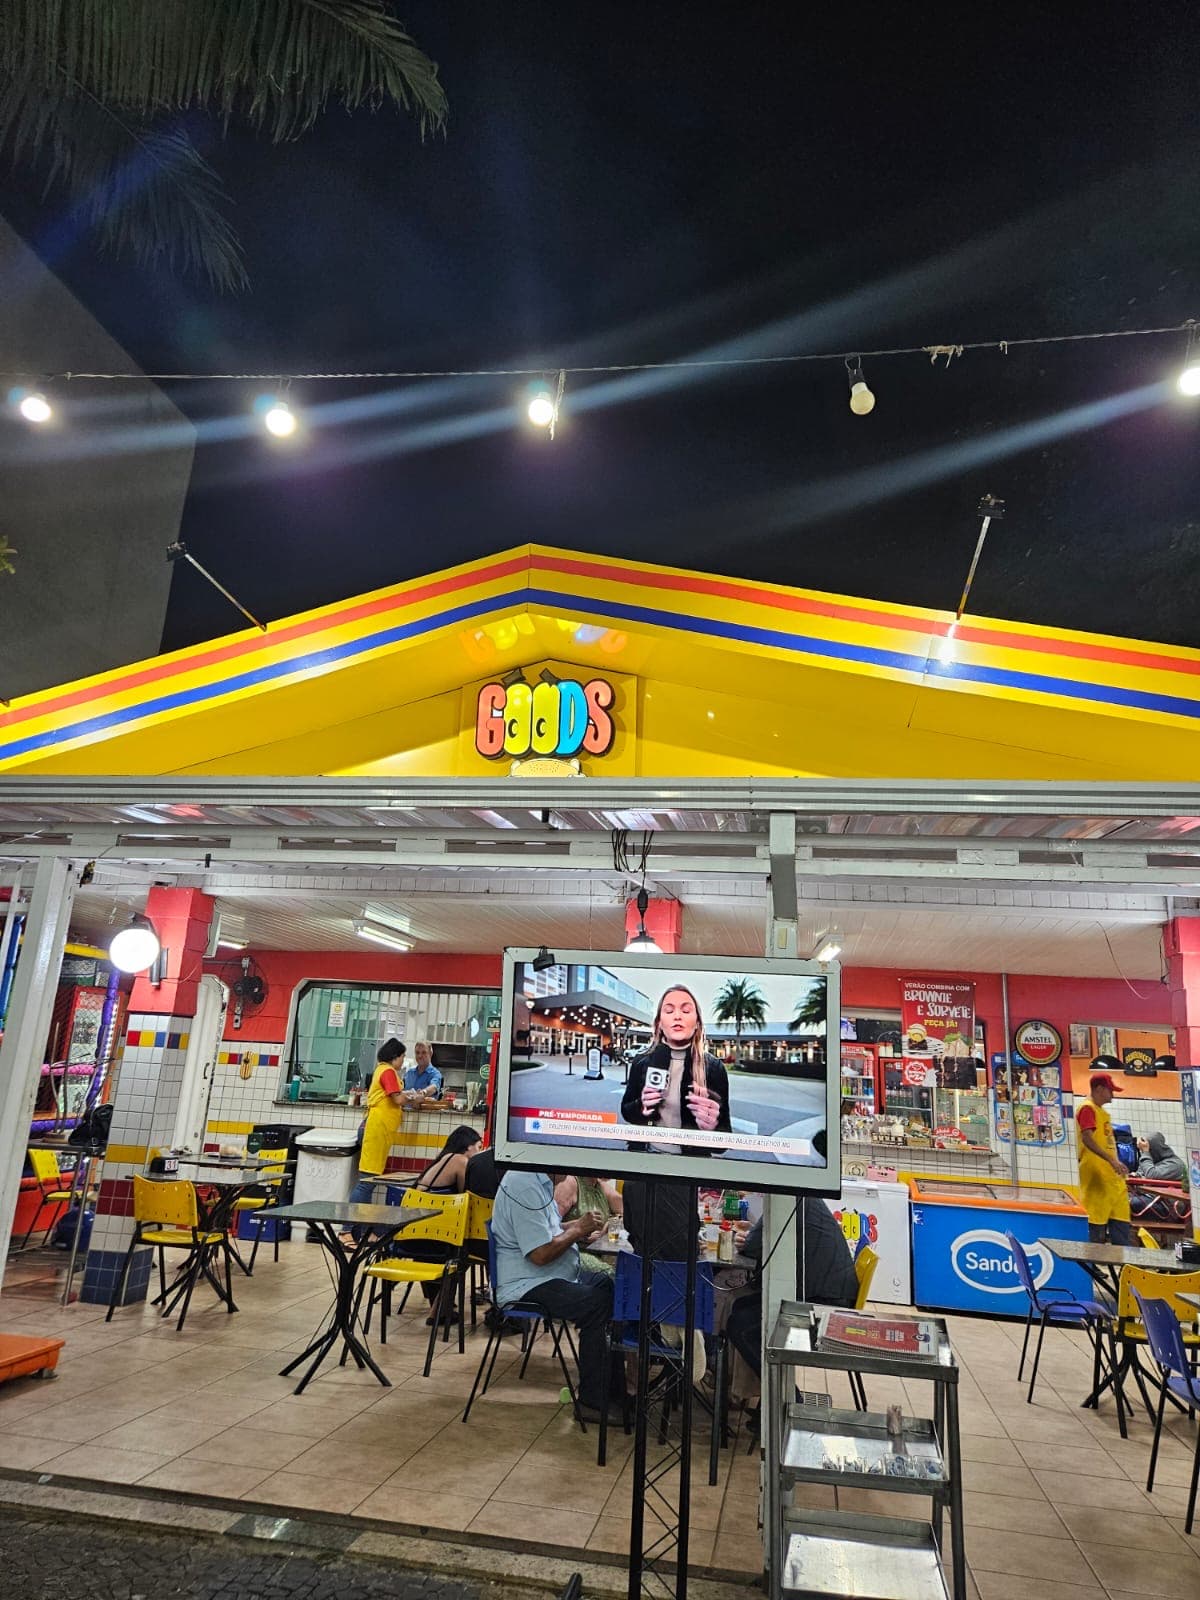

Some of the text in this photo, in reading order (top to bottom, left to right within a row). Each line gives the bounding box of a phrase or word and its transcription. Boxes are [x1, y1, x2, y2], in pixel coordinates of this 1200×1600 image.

[475, 679, 615, 760] GOODS
[904, 989, 953, 1004] BROWNIE
[917, 1004, 925, 1016] E
[923, 1019, 945, 1028] PEÇA
[1024, 1036, 1053, 1044] AMSTEL
[538, 1110, 603, 1121] PRÉ-TEMPORADA
